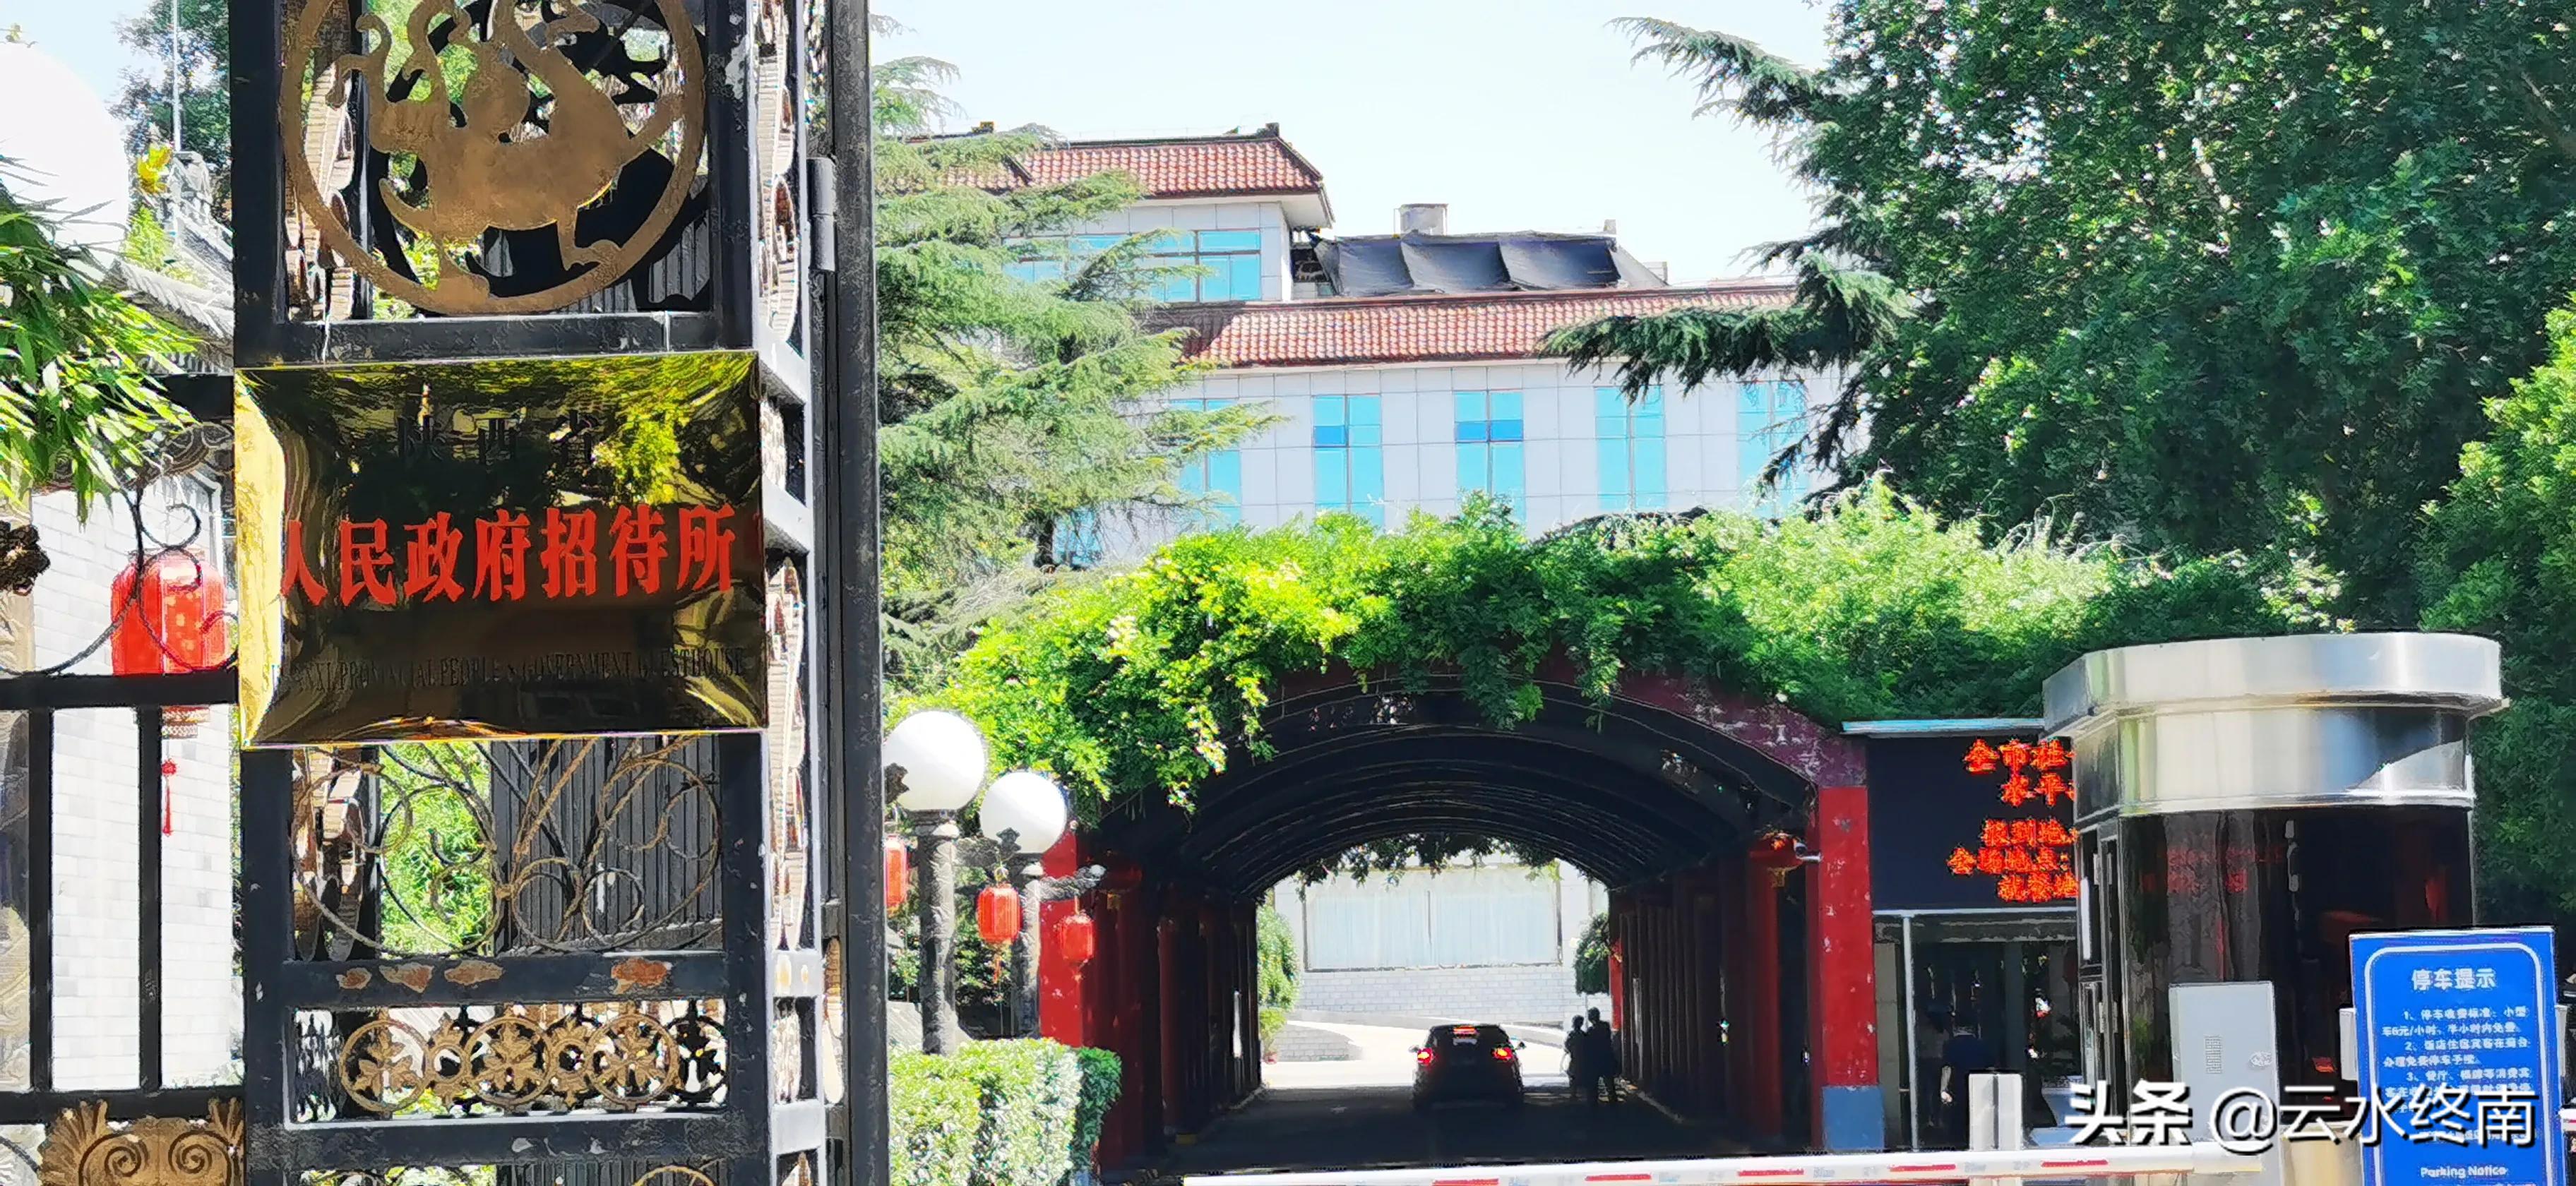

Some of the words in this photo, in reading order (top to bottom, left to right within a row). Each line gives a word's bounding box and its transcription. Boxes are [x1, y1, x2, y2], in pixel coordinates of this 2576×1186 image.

[280, 503, 737, 606] 人民政府招待所
[1981, 817, 2077, 847] 报到地
[2411, 968, 2496, 991] 停车提示
[2420, 1166, 2466, 1179] Parking
[2467, 1164, 2508, 1176] Notice
